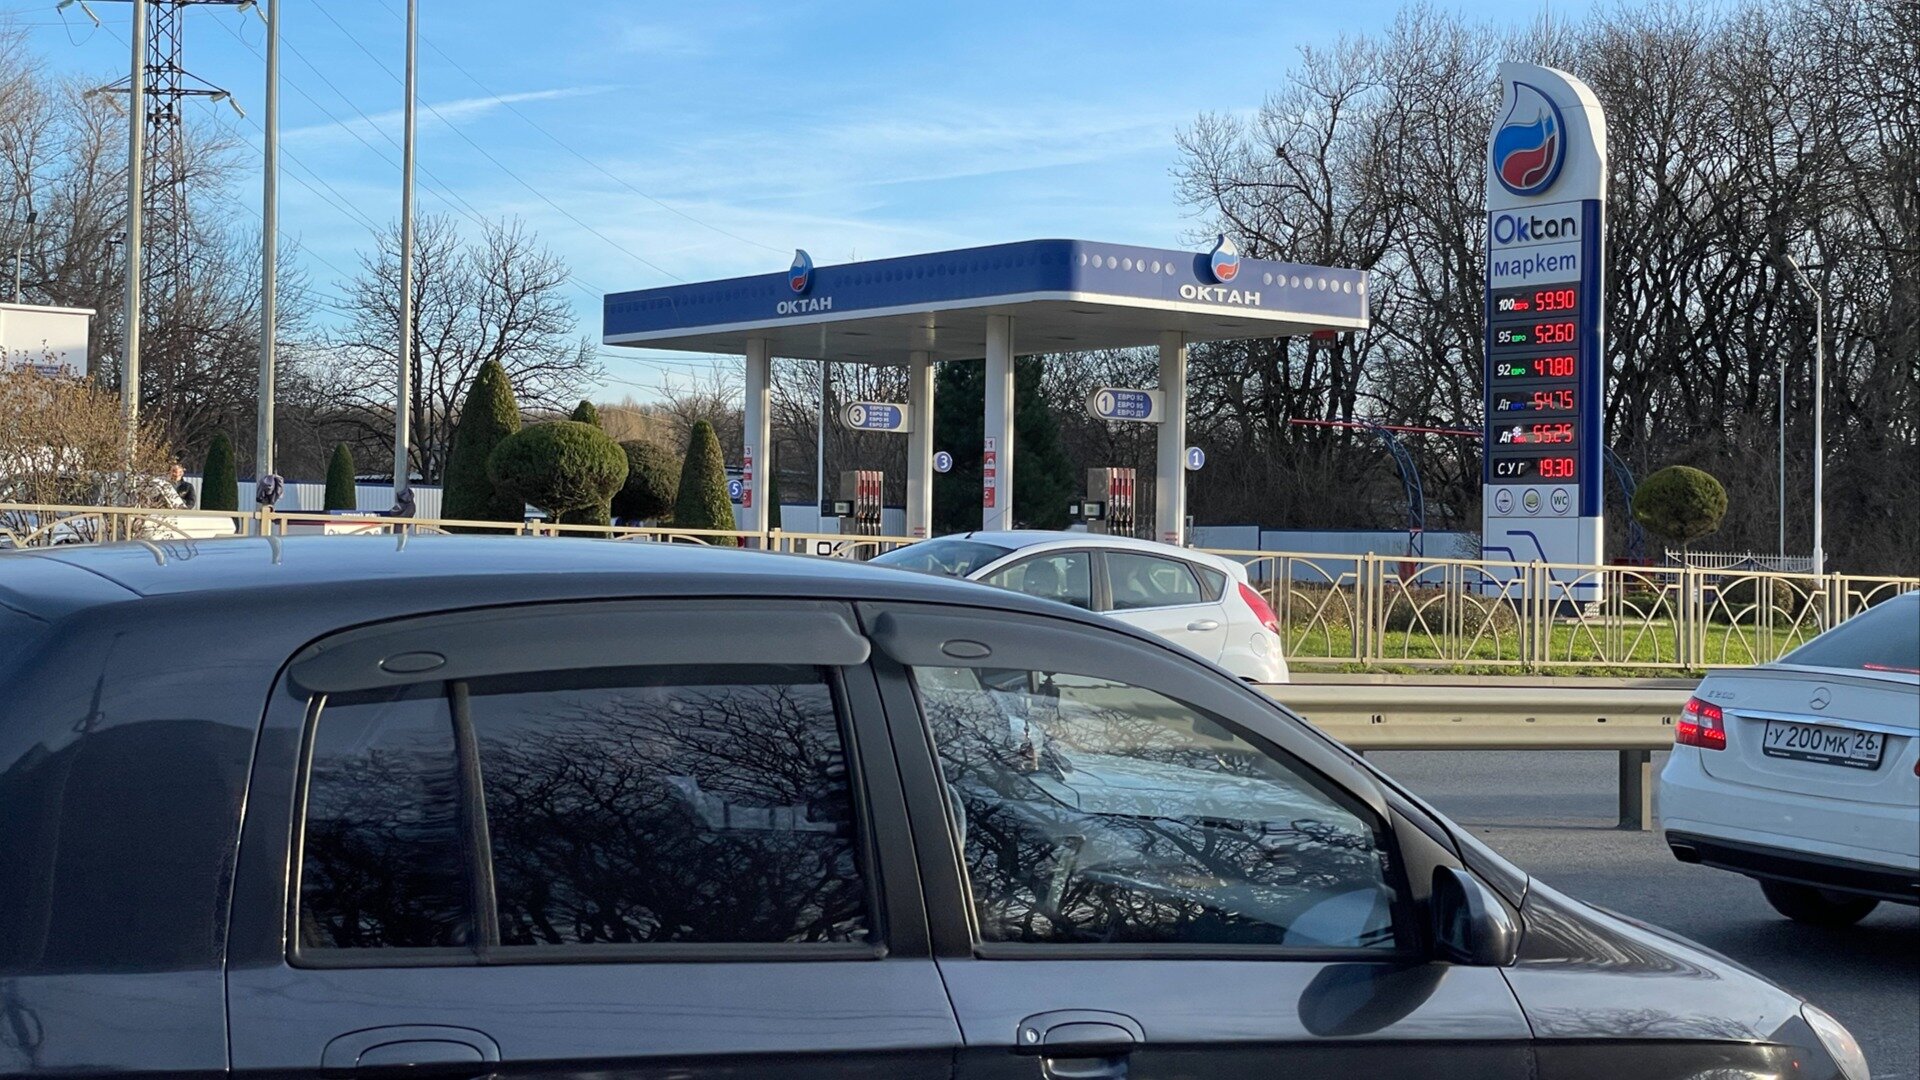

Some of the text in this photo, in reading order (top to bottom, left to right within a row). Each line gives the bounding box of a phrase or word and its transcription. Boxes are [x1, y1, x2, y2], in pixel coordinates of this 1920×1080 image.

[1494, 215, 1576, 244] Oktan
[1180, 284, 1261, 306] ОКТАН
[1499, 298, 1515, 311] 100
[1535, 290, 1574, 311] 59.90
[777, 296, 832, 315] ОКТАН
[1498, 331, 1511, 343] 95
[1535, 323, 1574, 344] 52.60
[1497, 364, 1511, 376] 92
[1534, 357, 1574, 376] 47.80
[1102, 395, 1108, 411] 1
[1534, 390, 1574, 411] 54.75
[853, 408, 862, 423] 3
[940, 455, 948, 469] 3
[1193, 451, 1200, 466] 1
[1540, 458, 1574, 478] 19.30
[731, 483, 739, 495] 5
[1553, 496, 1567, 505] WC
[1855, 733, 1876, 751] 26
